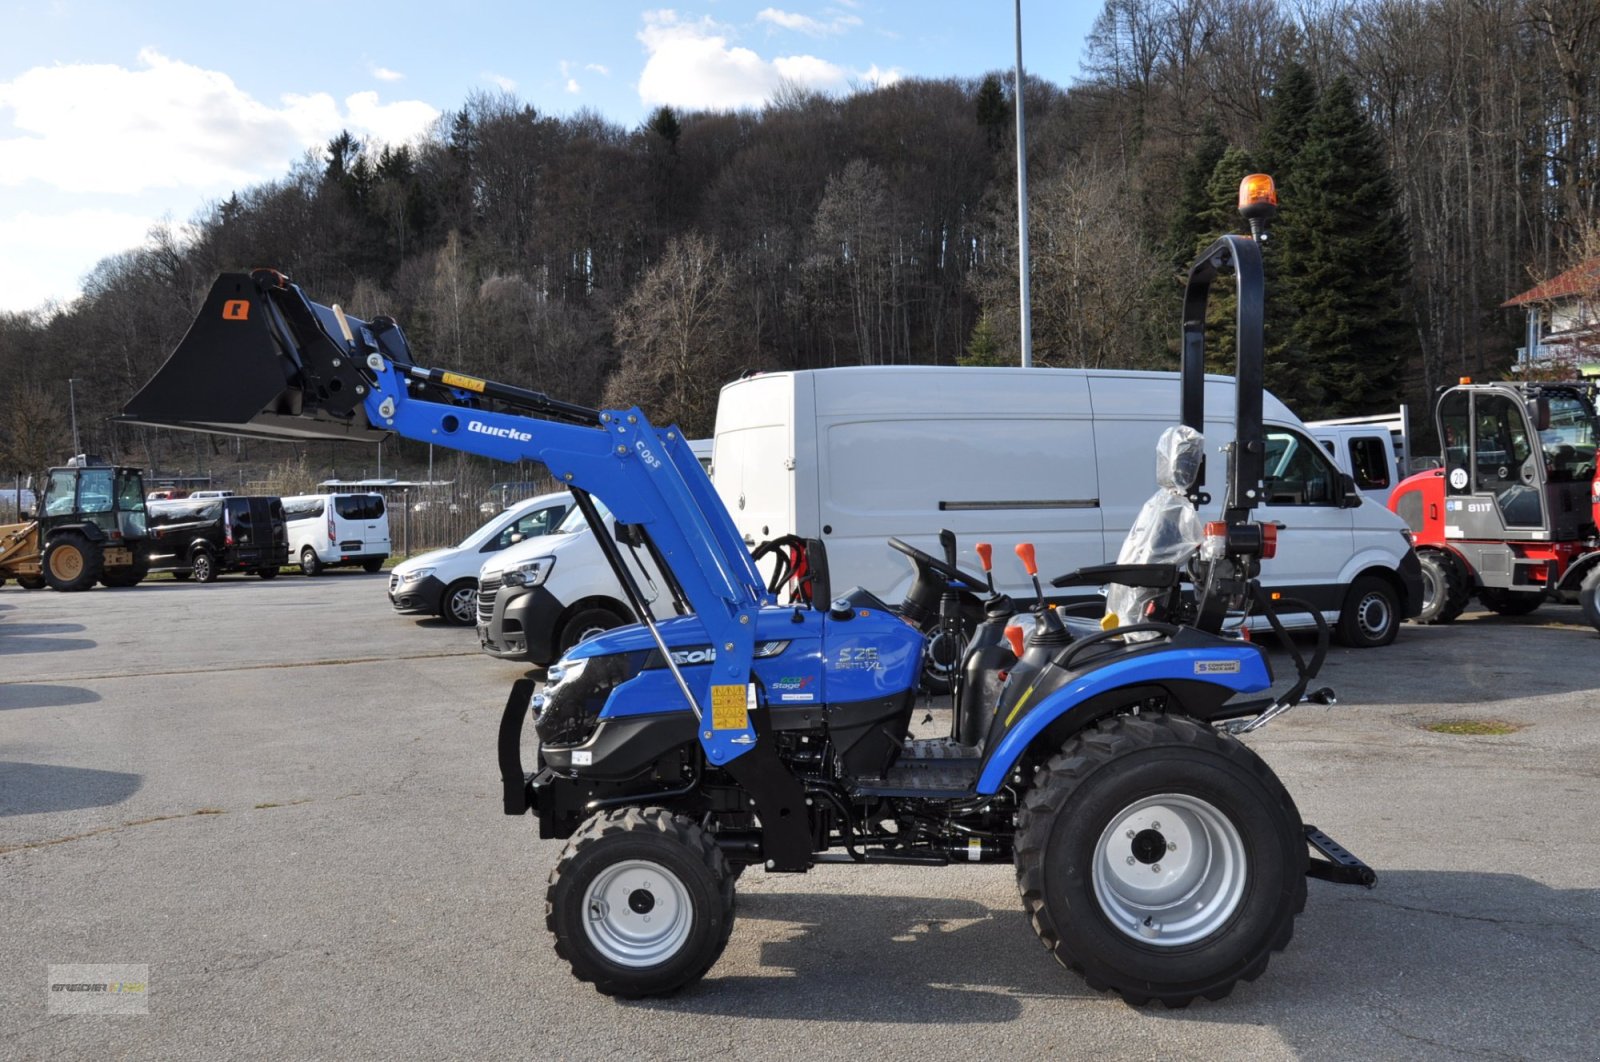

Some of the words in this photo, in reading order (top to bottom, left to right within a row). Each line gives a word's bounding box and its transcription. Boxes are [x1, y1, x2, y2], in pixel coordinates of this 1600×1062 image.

[467, 420, 533, 442] Quicke
[1454, 472, 1464, 485] 20
[1468, 503, 1492, 512] 811T
[839, 647, 852, 662] S
